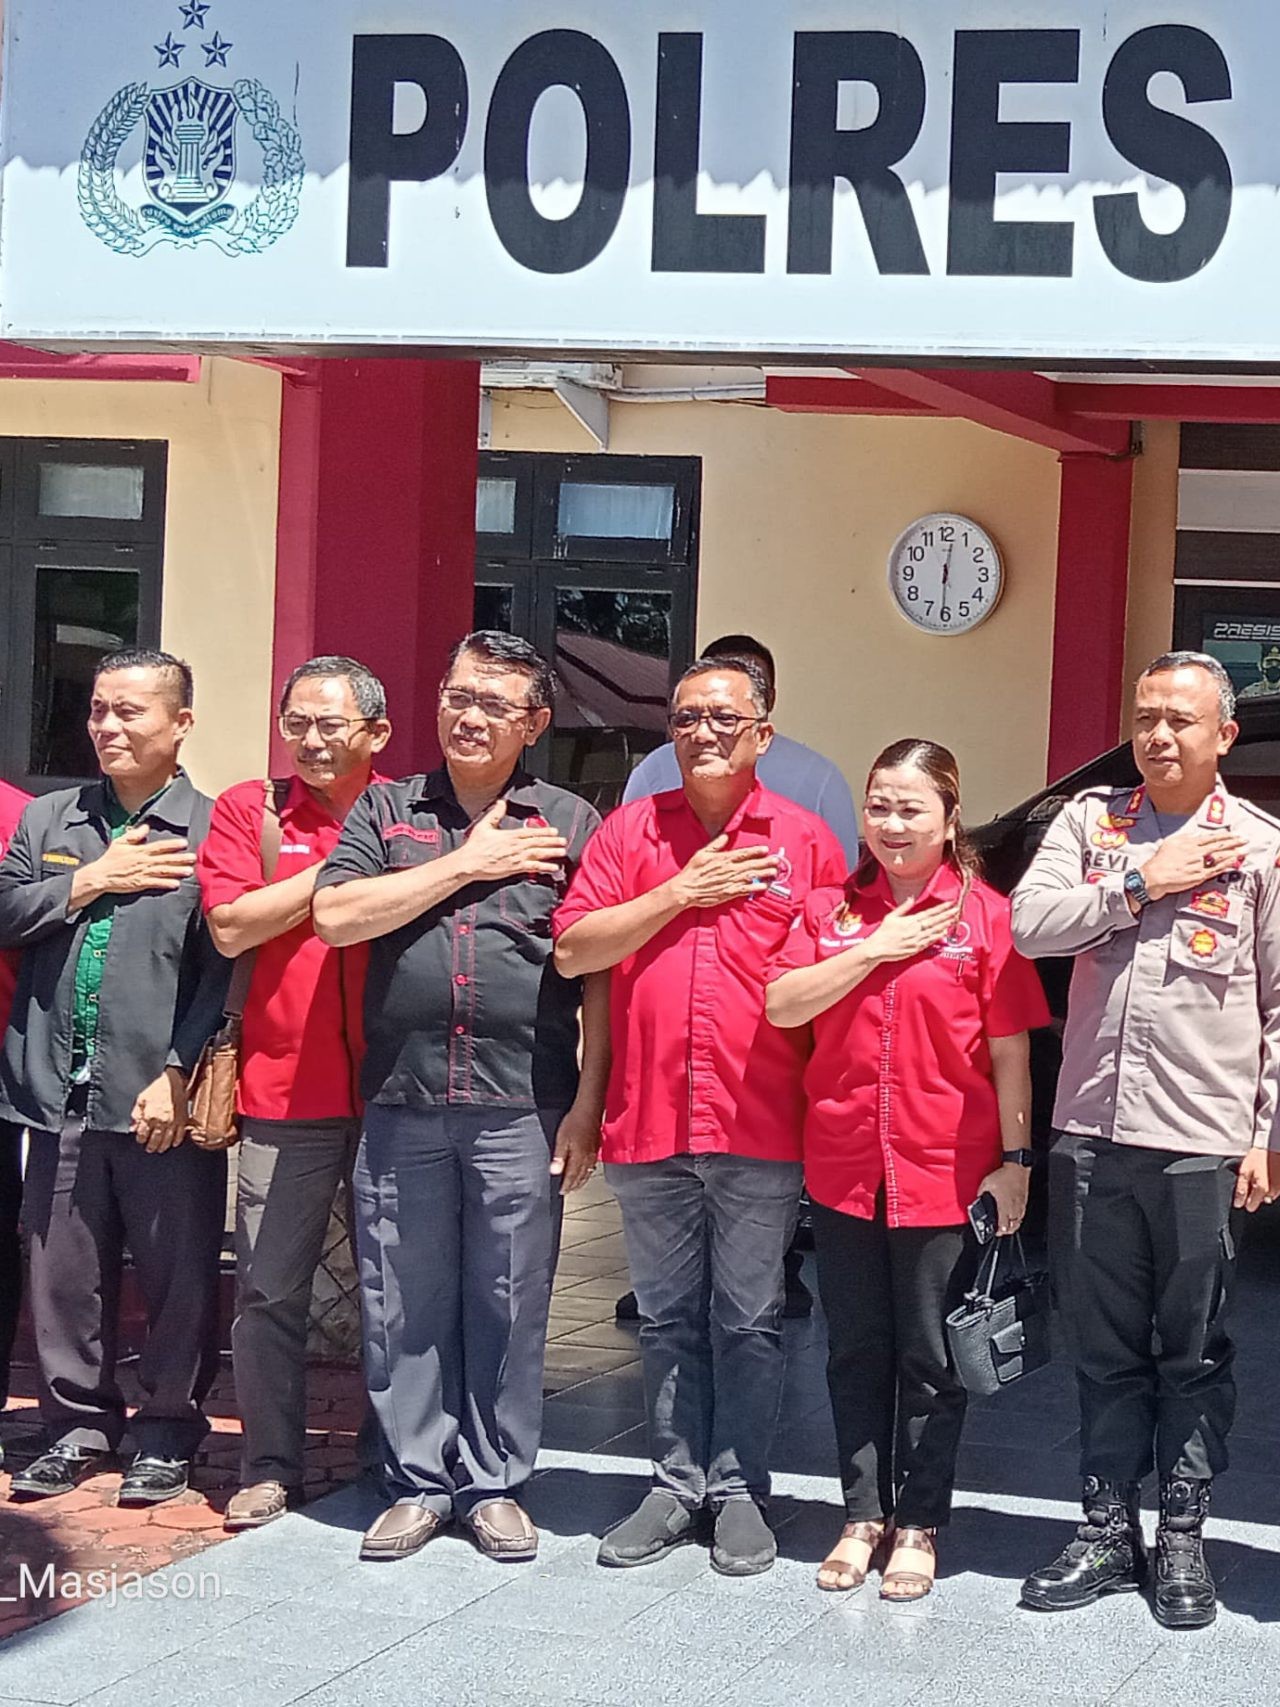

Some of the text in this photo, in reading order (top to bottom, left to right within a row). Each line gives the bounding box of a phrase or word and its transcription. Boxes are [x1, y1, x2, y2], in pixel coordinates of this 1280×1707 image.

[346, 24, 1233, 284] POLRES
[922, 531, 934, 547] 11
[938, 526, 955, 542] 12
[962, 531, 969, 547] 1
[907, 546, 925, 562] 10
[972, 547, 984, 563] 2
[902, 565, 915, 581] 9
[978, 567, 989, 583] 3
[907, 585, 919, 601] 8
[972, 587, 984, 602] 4
[924, 600, 935, 616] 7
[940, 606, 951, 622] 6
[958, 601, 970, 617] 5
